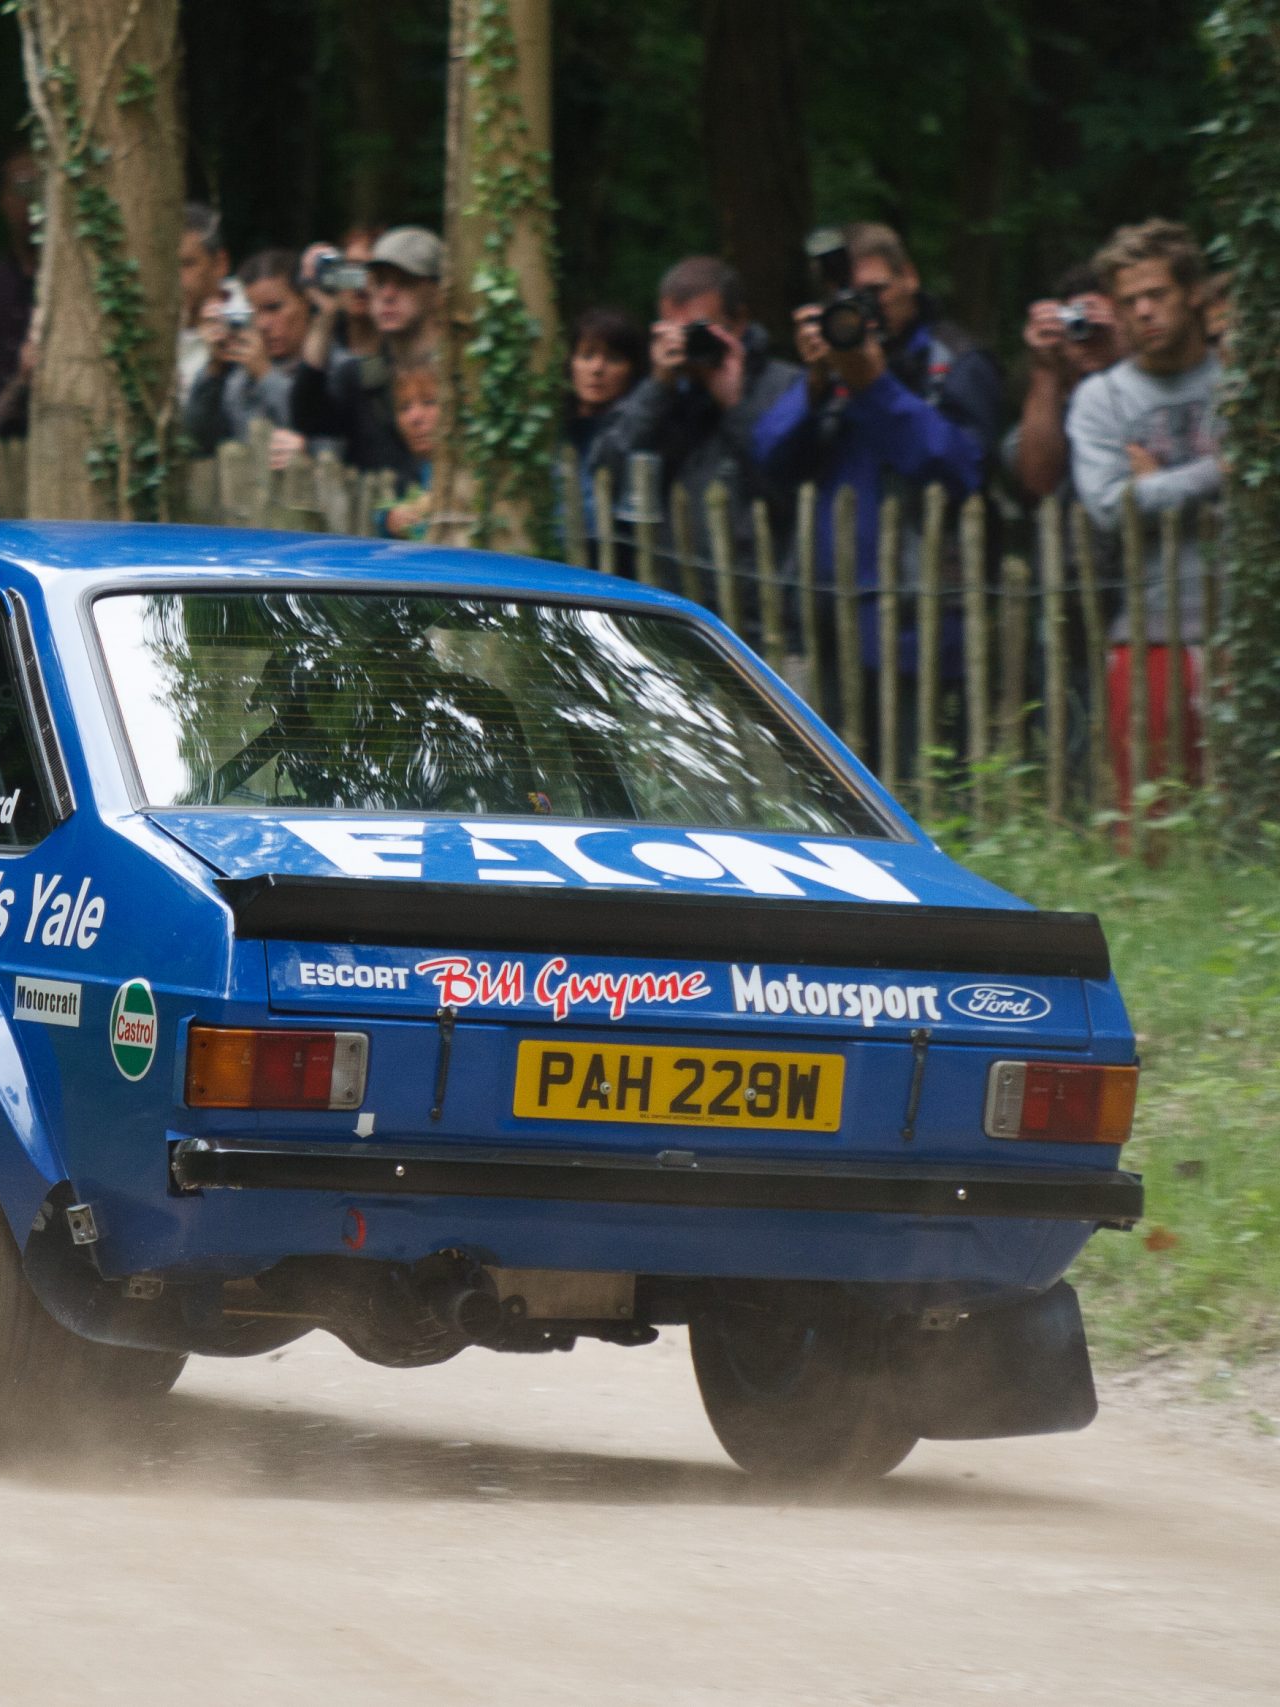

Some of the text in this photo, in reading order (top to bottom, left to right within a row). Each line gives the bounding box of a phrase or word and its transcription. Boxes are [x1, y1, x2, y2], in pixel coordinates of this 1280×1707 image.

[24, 873, 105, 950] Yale
[300, 962, 410, 990] ESCORT
[415, 954, 942, 1028] Bill Gwynne Motorsport
[17, 985, 78, 1016] Motorcraft
[967, 986, 1032, 1017] Ford
[116, 1015, 154, 1046] Castrol
[537, 1051, 654, 1112] PAH
